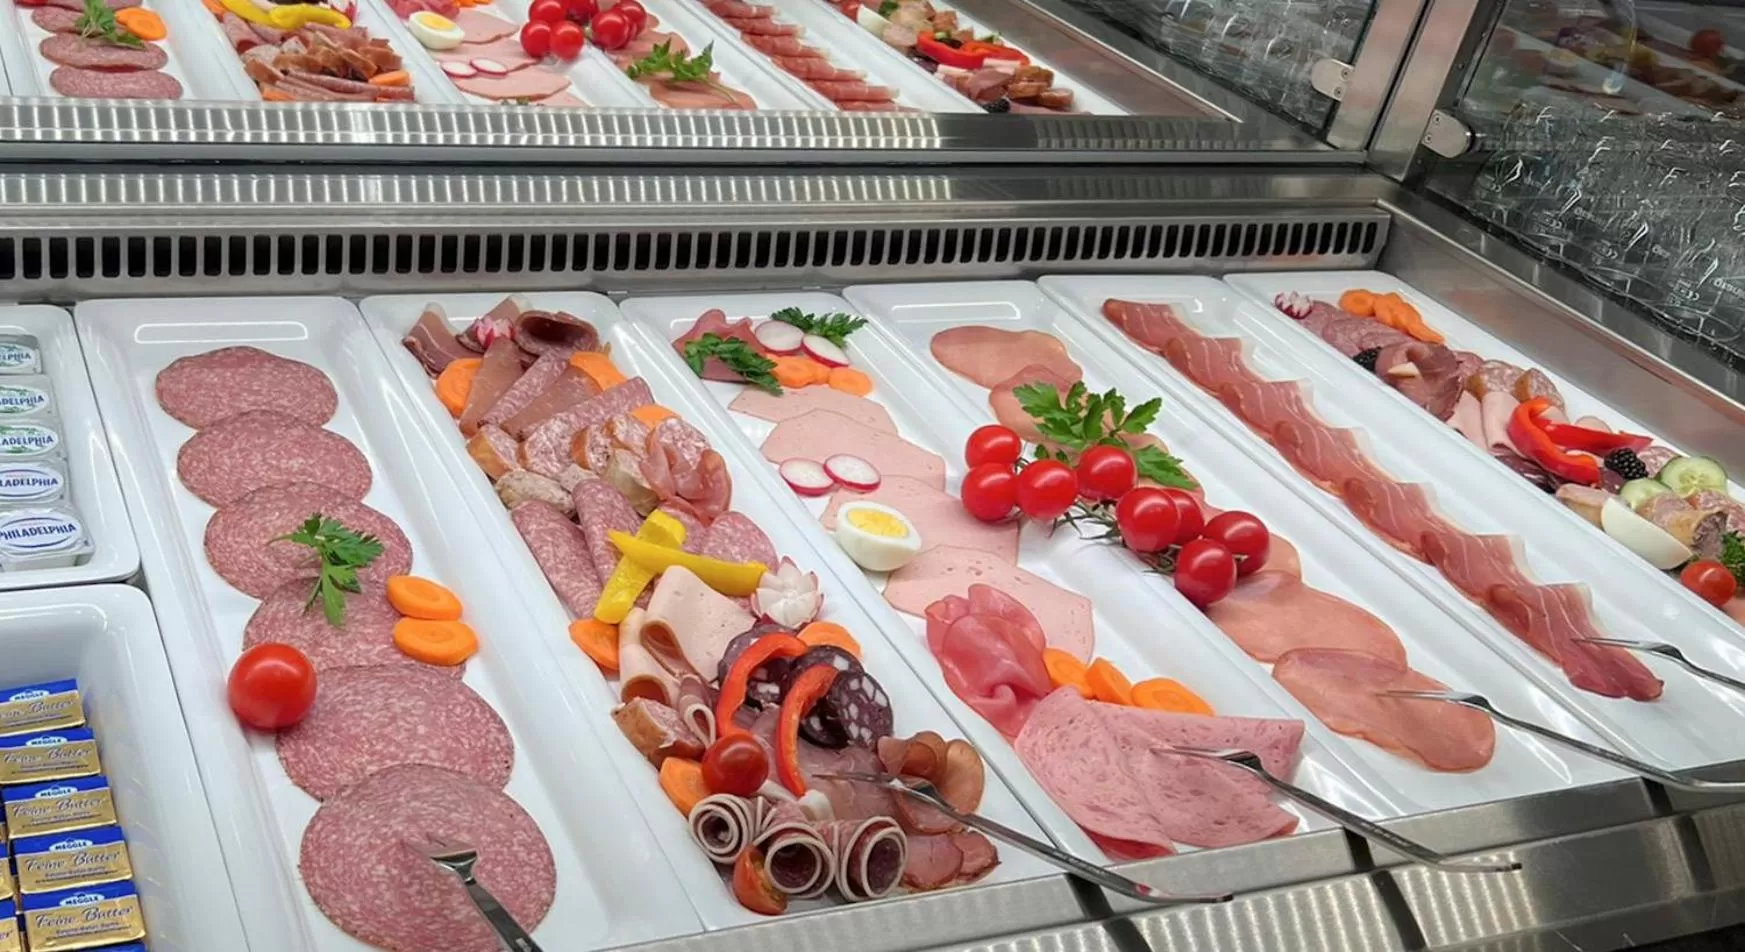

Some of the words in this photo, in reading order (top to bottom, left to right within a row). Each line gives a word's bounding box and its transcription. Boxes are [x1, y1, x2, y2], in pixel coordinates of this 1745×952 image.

[46, 748, 92, 760] Butter
[56, 797, 107, 811] Butter
[25, 858, 65, 872] Feine
[71, 850, 120, 866] Butter
[35, 912, 77, 929] Feine
[82, 905, 134, 921] Butter
